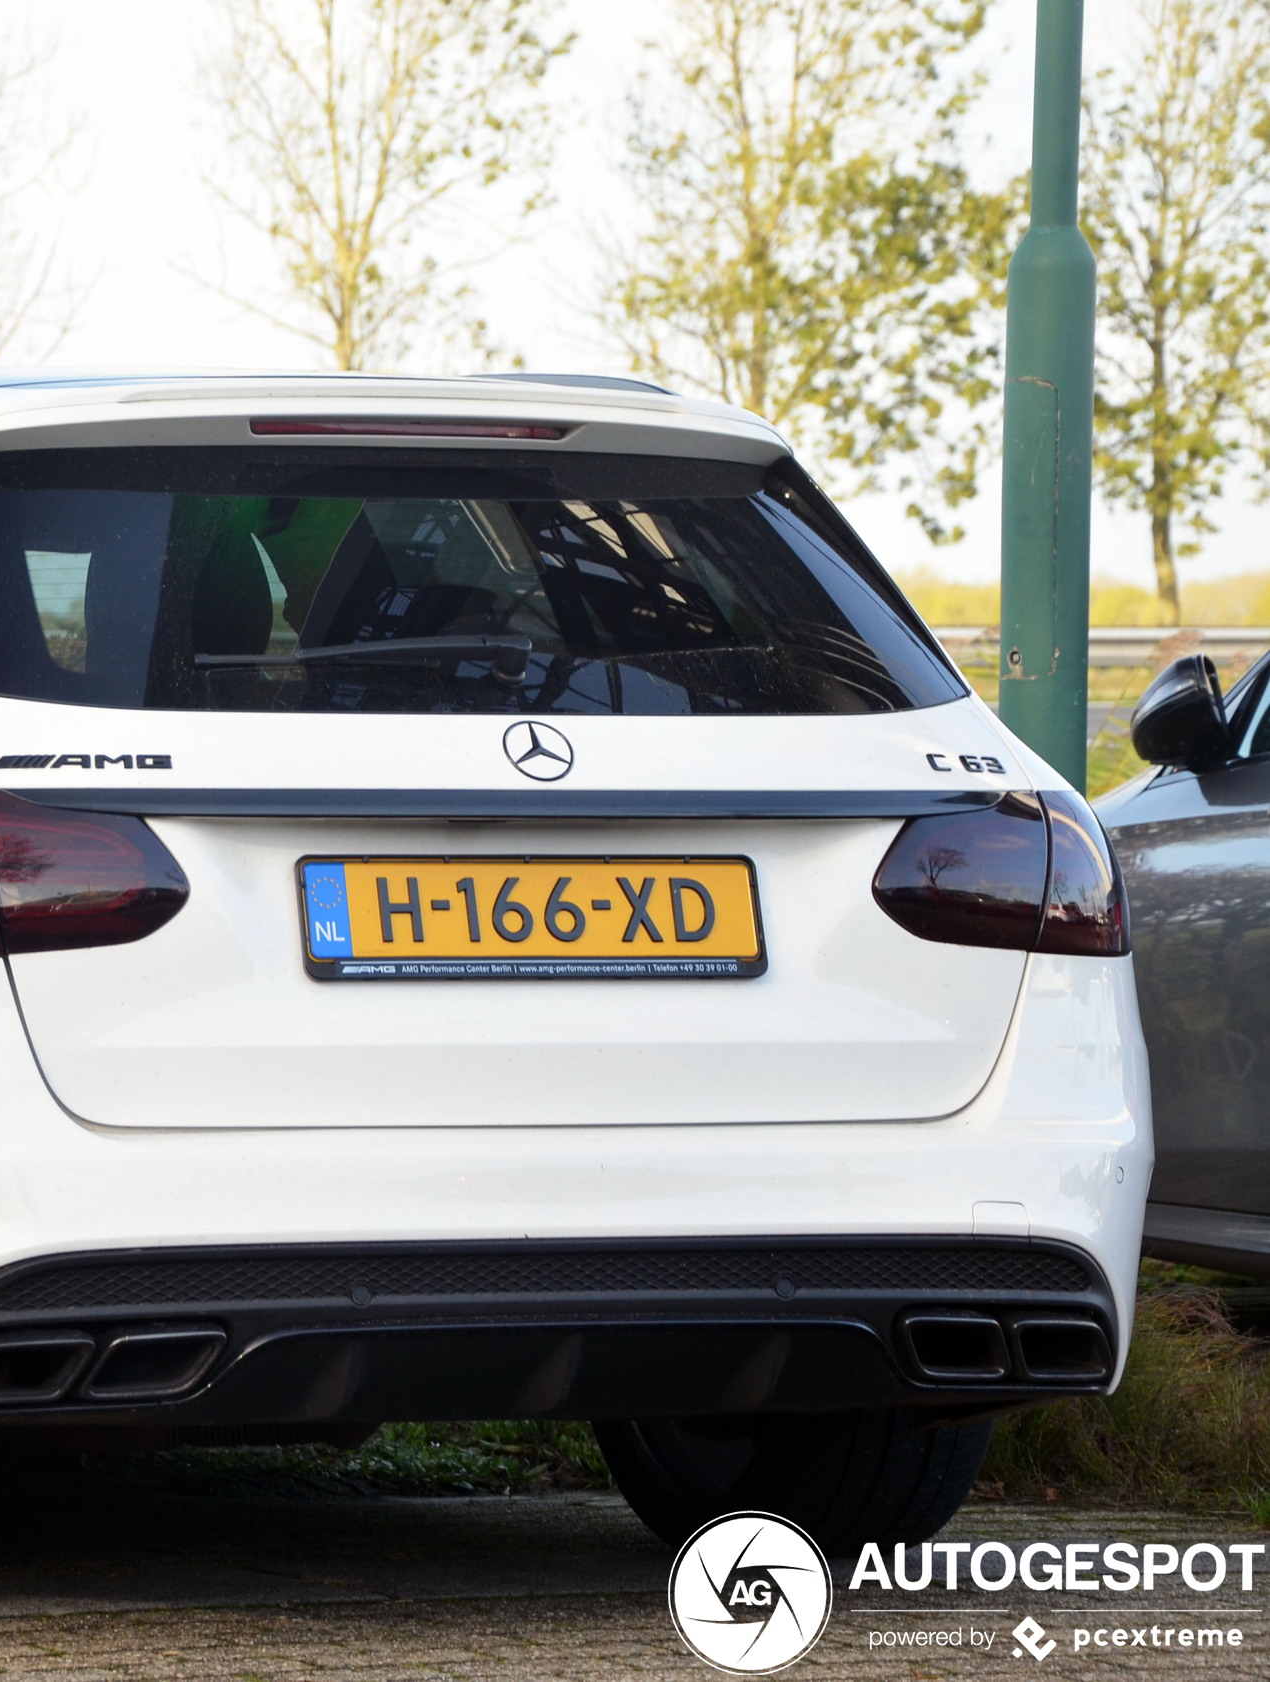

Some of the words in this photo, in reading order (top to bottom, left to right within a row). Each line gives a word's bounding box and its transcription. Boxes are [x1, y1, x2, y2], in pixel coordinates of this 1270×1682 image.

[50, 754, 172, 769] AMG
[926, 753, 952, 772] C
[959, 755, 1006, 774] 63
[376, 876, 716, 943] H-166-XD
[315, 921, 346, 942] NL
[358, 965, 396, 974] AMG
[401, 965, 419, 974] AMG
[420, 965, 465, 974] Performance
[466, 965, 490, 973] Center
[491, 964, 512, 973] Berlin
[519, 964, 646, 974] www.amg-performance-center.berlin
[653, 964, 679, 972] Telefon
[680, 963, 693, 972] +49
[695, 963, 705, 972] 30
